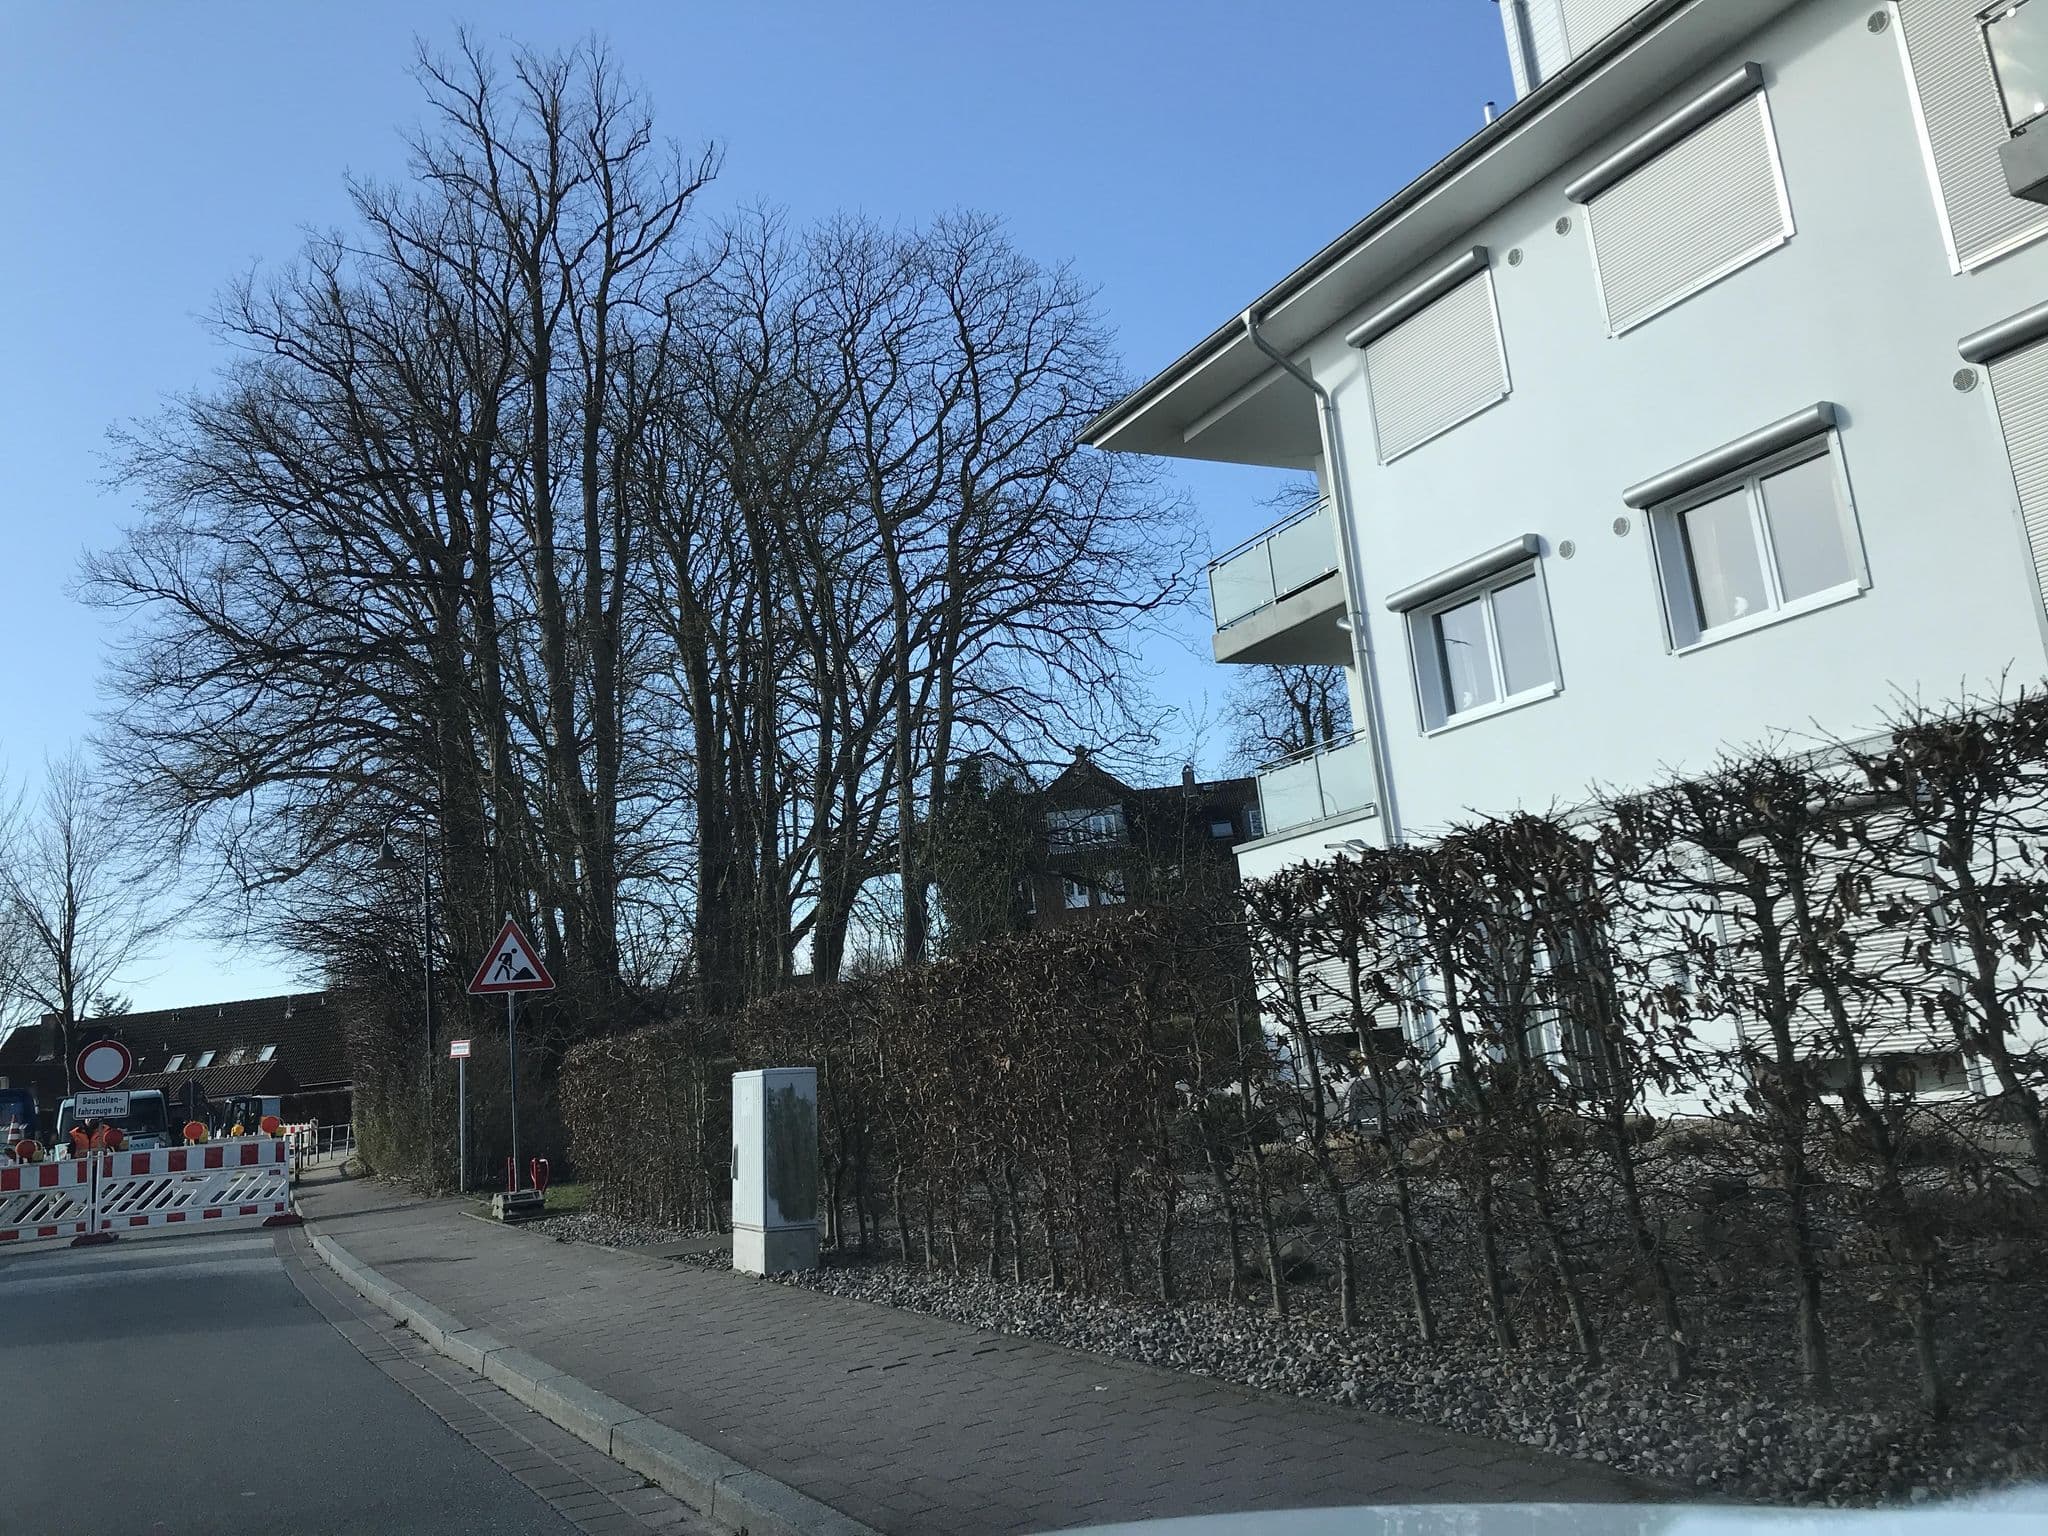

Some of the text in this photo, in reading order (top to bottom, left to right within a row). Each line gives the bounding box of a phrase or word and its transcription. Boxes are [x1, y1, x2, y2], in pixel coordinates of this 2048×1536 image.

[82, 1096, 124, 1105] Baustellen-
[78, 1105, 126, 1116] fahrzeuge frei
